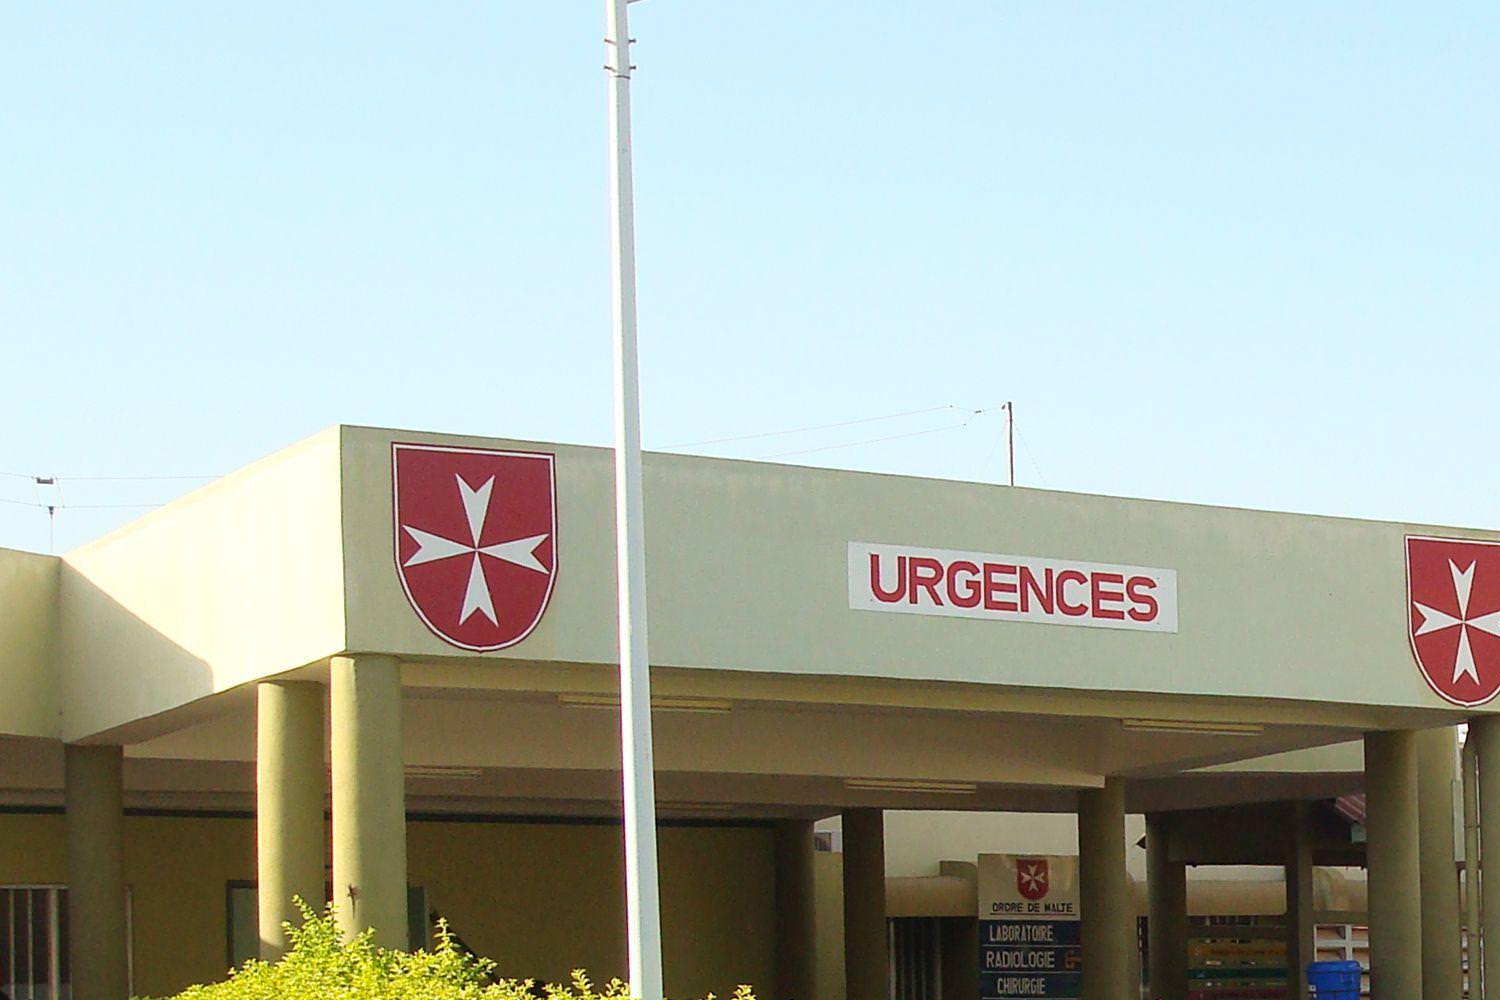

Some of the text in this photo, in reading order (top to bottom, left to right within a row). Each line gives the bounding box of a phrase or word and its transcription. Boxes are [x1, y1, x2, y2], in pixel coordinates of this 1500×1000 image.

[870, 554, 1158, 622] URGENCES
[993, 902, 1073, 913] ORDRE DE MALTE
[989, 924, 1053, 942] LABORATOIRE
[986, 951, 1055, 969] RADIOLOGIE
[997, 978, 1046, 995] CHIRURGIE
